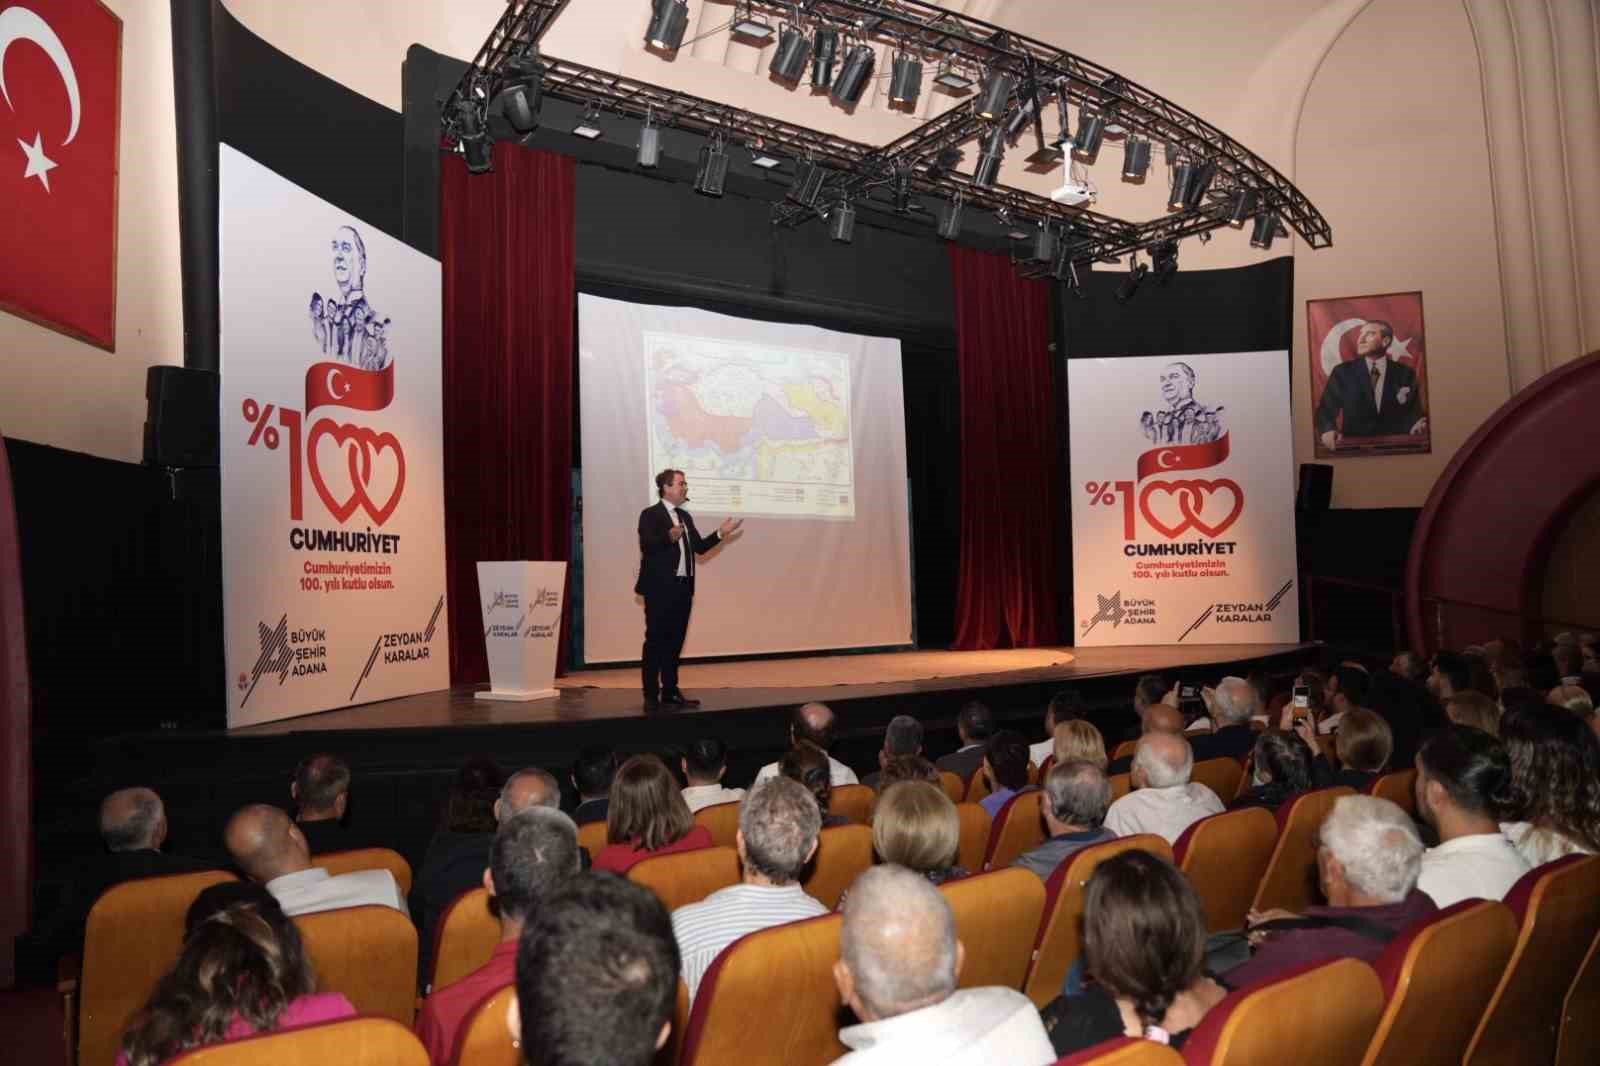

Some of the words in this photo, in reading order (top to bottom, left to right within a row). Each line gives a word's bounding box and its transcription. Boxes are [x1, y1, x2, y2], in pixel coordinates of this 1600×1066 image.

[289, 526, 400, 554] CUMHURİYET
[1124, 539, 1237, 556] CUMHURİYET
[303, 560, 392, 577] Cumhuriyetimizin
[1135, 560, 1227, 571] Cumhuriyetimizin
[1133, 570, 1153, 579] 100.
[1172, 569, 1197, 578] kutlu
[1199, 568, 1231, 577] olsun.
[300, 577, 322, 591] 100.
[342, 577, 367, 590] kutlu
[368, 577, 395, 590] olsun.
[1123, 598, 1156, 607] BÜYÜK
[1215, 603, 1264, 613] ZEYDAN
[1127, 608, 1156, 617] ŞEHİR
[1215, 613, 1272, 623] KARALAR
[1123, 617, 1156, 625] ADANA
[290, 628, 326, 643] BÜYÜK
[384, 632, 423, 648] ZEYDAN
[295, 643, 327, 663] ŞEHİR
[384, 647, 430, 664] KARALAR
[291, 663, 328, 677] ADANA
